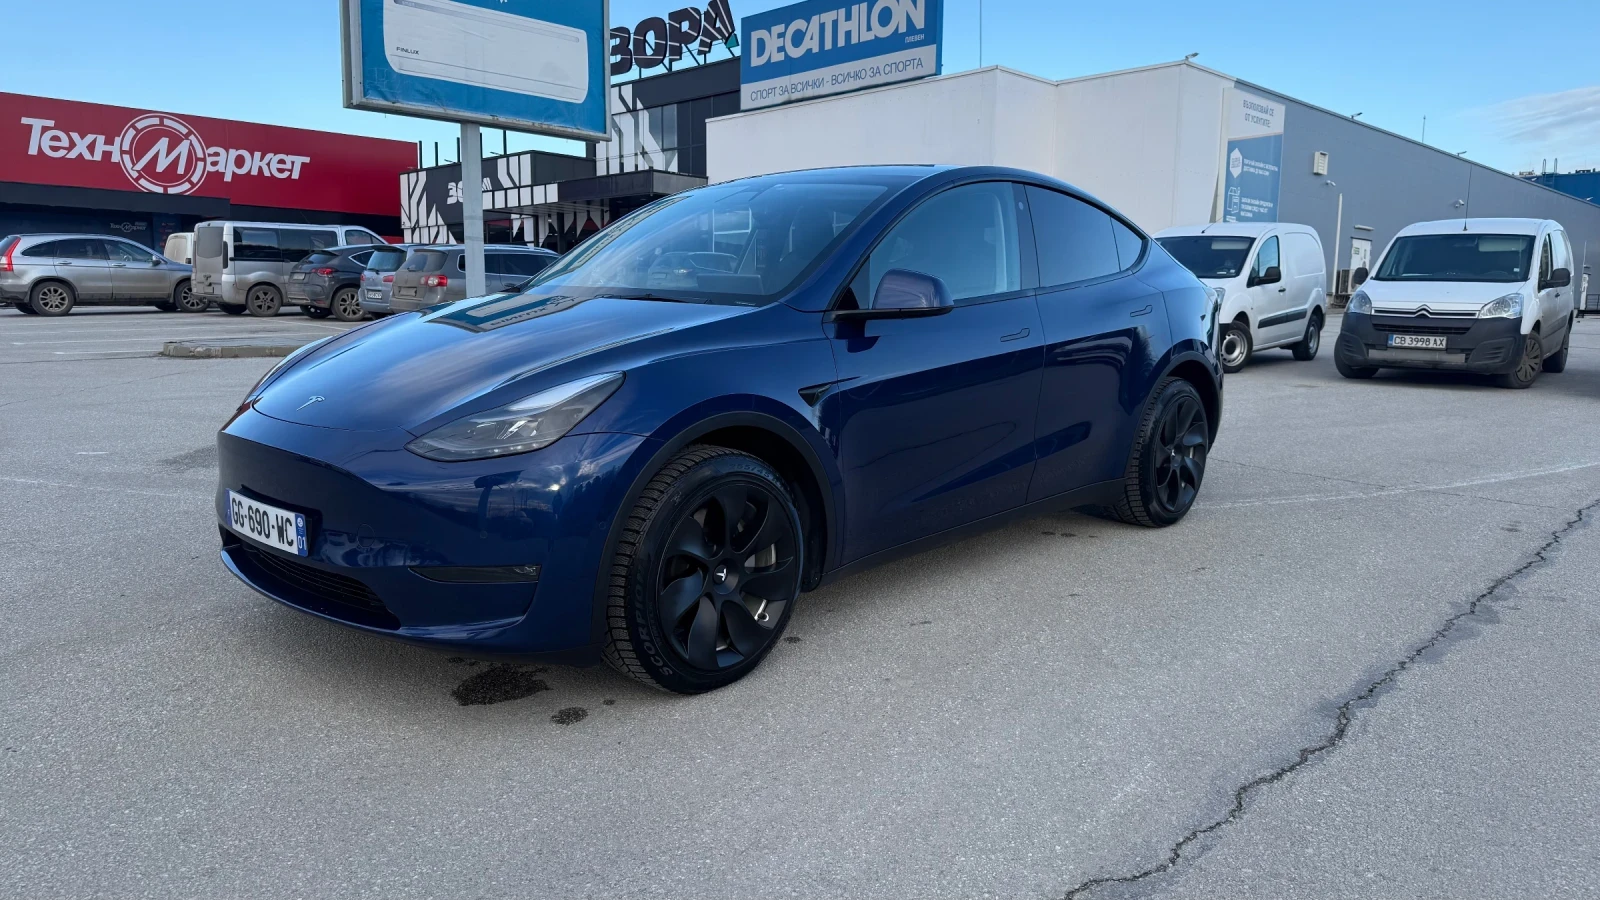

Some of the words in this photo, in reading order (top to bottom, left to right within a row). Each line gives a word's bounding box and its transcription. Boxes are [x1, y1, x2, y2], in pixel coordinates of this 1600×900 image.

[751, 0, 925, 67] DECATHLON
[750, 86, 777, 101] СПОРТ
[779, 85, 790, 96] ЗА
[791, 77, 825, 94] ВСИЧКИ
[831, 68, 867, 86] ВСИЧКО
[869, 66, 881, 78] ЗА
[883, 57, 923, 76] СПОРТА
[1394, 336, 1406, 346] CB
[1408, 337, 1431, 347] 3998
[1433, 338, 1445, 347] AX
[231, 497, 294, 547] GG-690-WC
